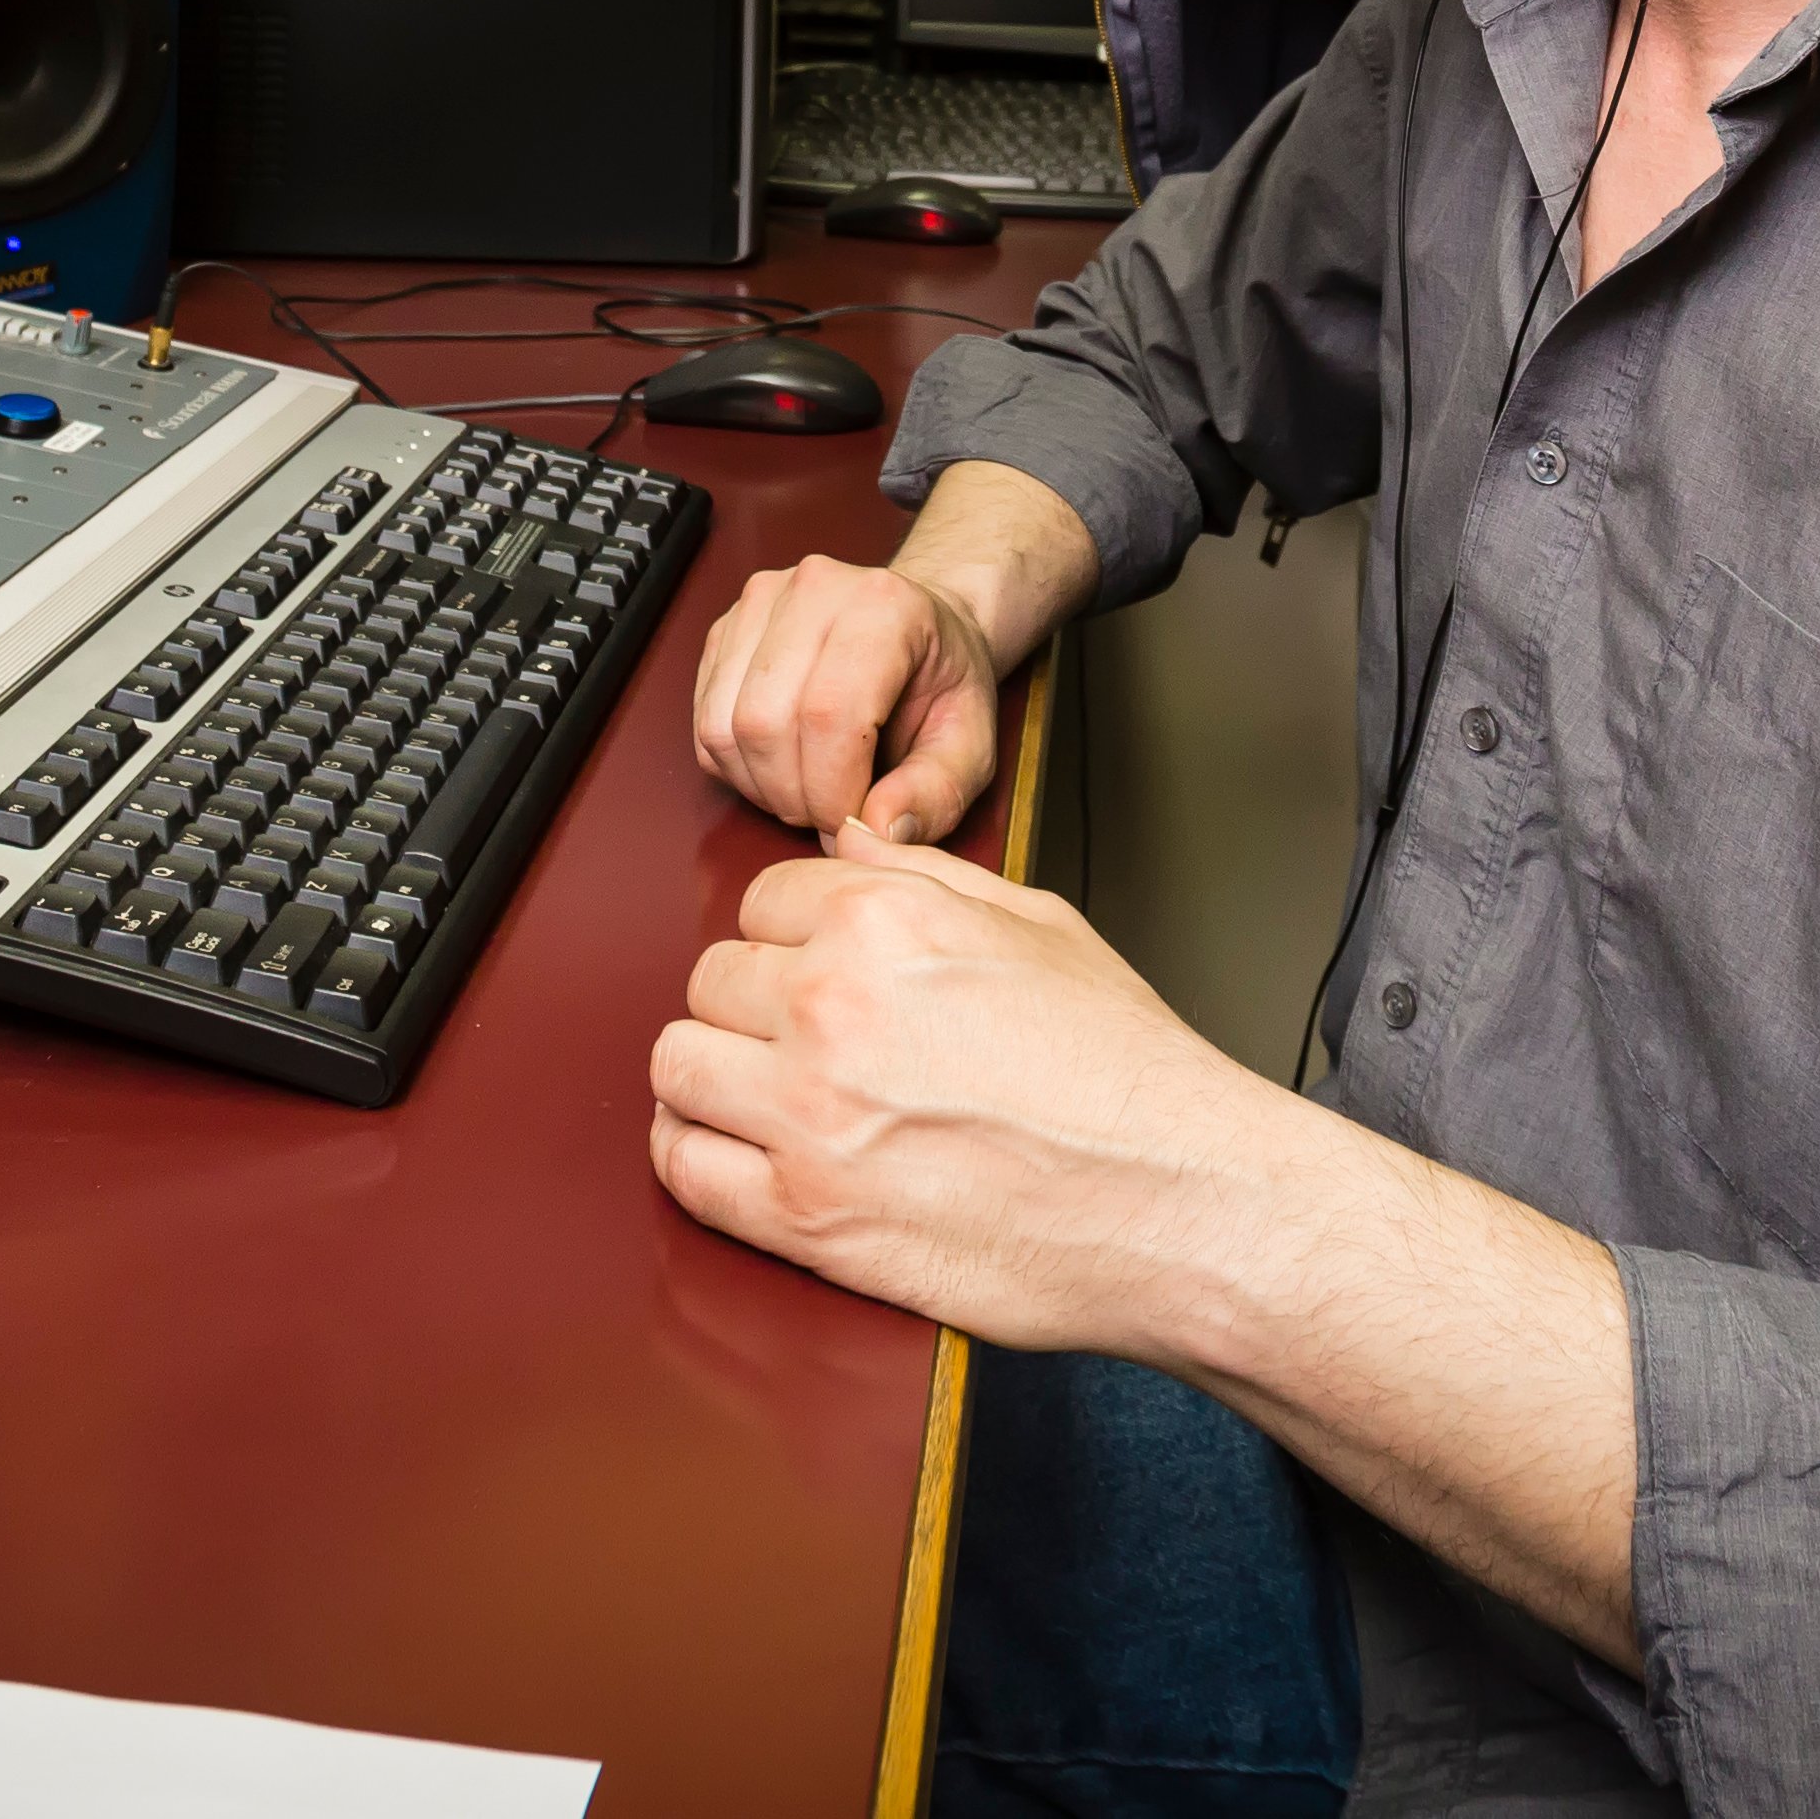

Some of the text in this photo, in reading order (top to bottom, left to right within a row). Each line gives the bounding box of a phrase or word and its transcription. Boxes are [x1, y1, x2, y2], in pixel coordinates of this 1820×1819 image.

[248, 701, 262, 710] 7
[297, 699, 315, 709] U
[225, 726, 241, 734] 6
[276, 723, 295, 733] Y
[341, 733, 363, 745] H
[202, 752, 218, 761] 5
[253, 750, 273, 759] T
[321, 759, 342, 770] G
[390, 763, 412, 774] B
[39, 774, 57, 784] F2
[178, 780, 193, 788] 4
[229, 777, 251, 788] R
[299, 787, 318, 798] F
[372, 790, 393, 801] V
[8, 803, 26, 814] F1
[152, 808, 169, 817] 3
[206, 806, 227, 816] E
[276, 816, 297, 827] D
[351, 818, 373, 830] C
[123, 837, 141, 848] 2
[180, 831, 204, 845] W
[252, 845, 274, 857] S
[329, 848, 353, 860] X
[95, 871, 112, 879] 1
[151, 866, 176, 878] Q
[228, 878, 252, 889] A
[305, 879, 329, 891] Z
[120, 918, 142, 931] Tab
[184, 931, 209, 950] Caps
[198, 937, 222, 954] Lock
[335, 977, 355, 992] Ctrl
